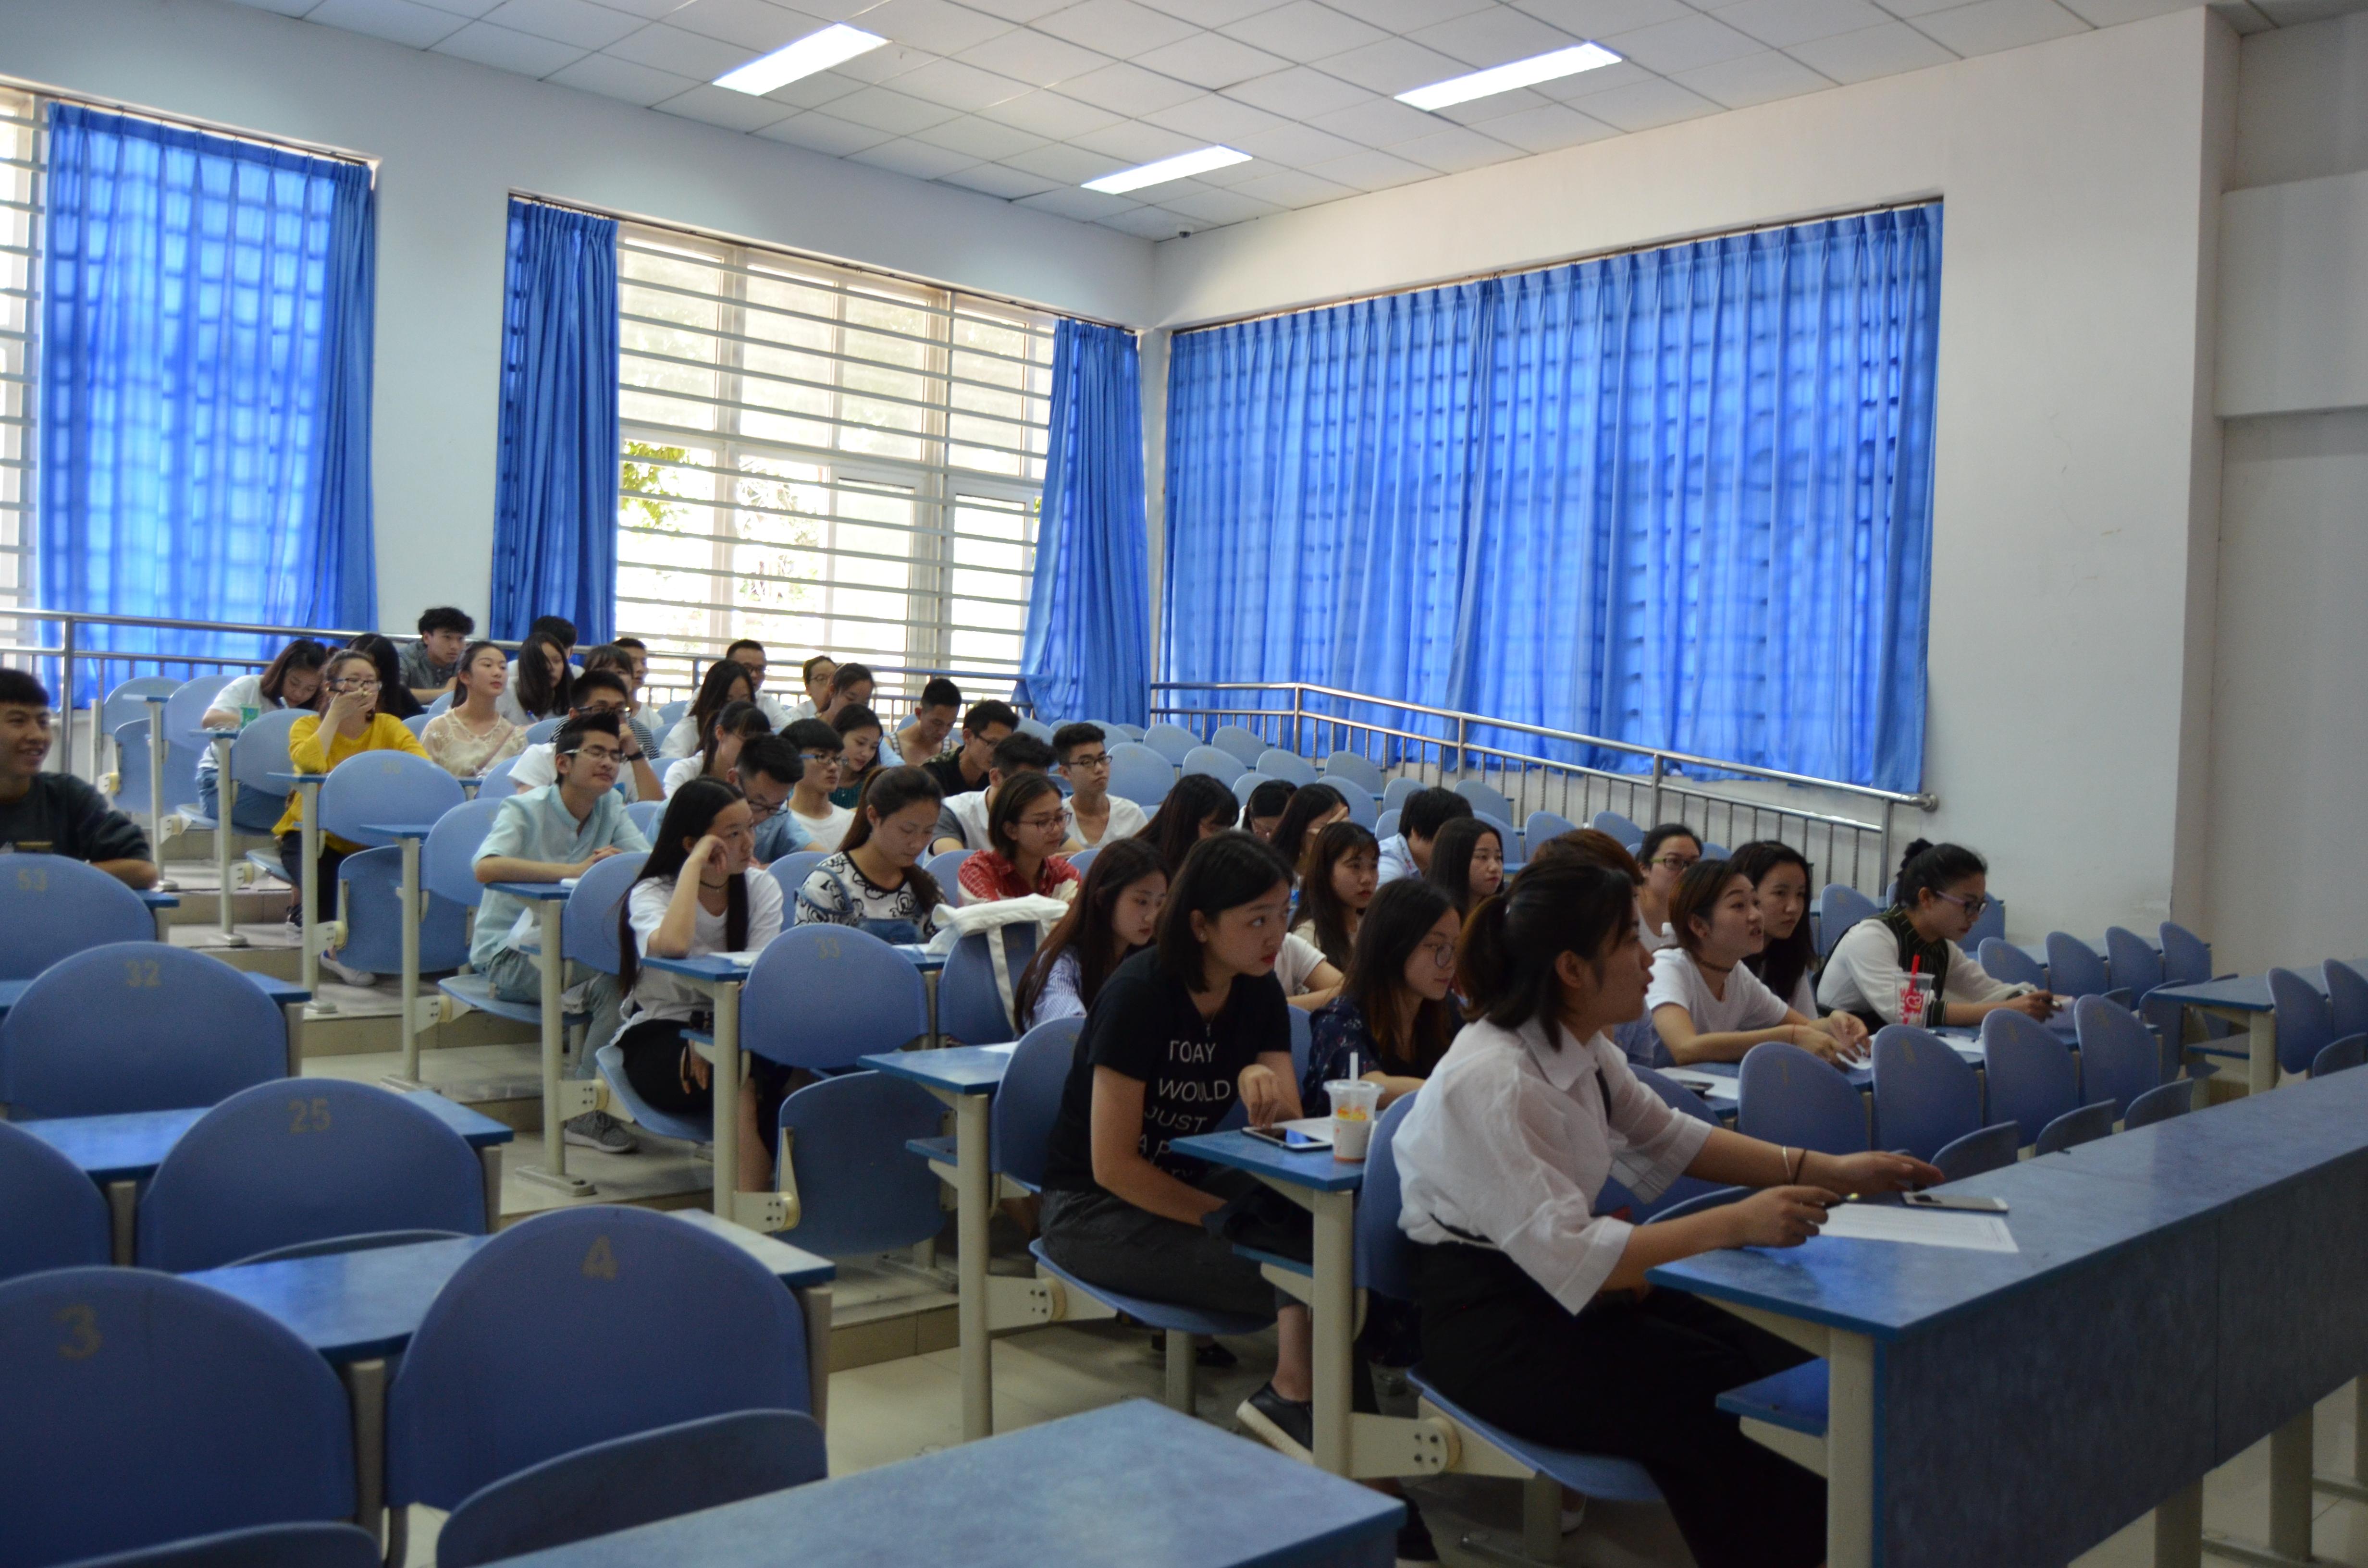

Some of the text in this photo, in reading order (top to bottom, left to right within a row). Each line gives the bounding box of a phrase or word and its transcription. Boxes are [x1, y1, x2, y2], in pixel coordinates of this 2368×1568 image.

[124, 960, 161, 987] 32
[286, 1099, 331, 1134] 25
[1145, 1106, 1208, 1134] JUST
[580, 1235, 619, 1281] 4
[52, 1304, 102, 1360] 3
